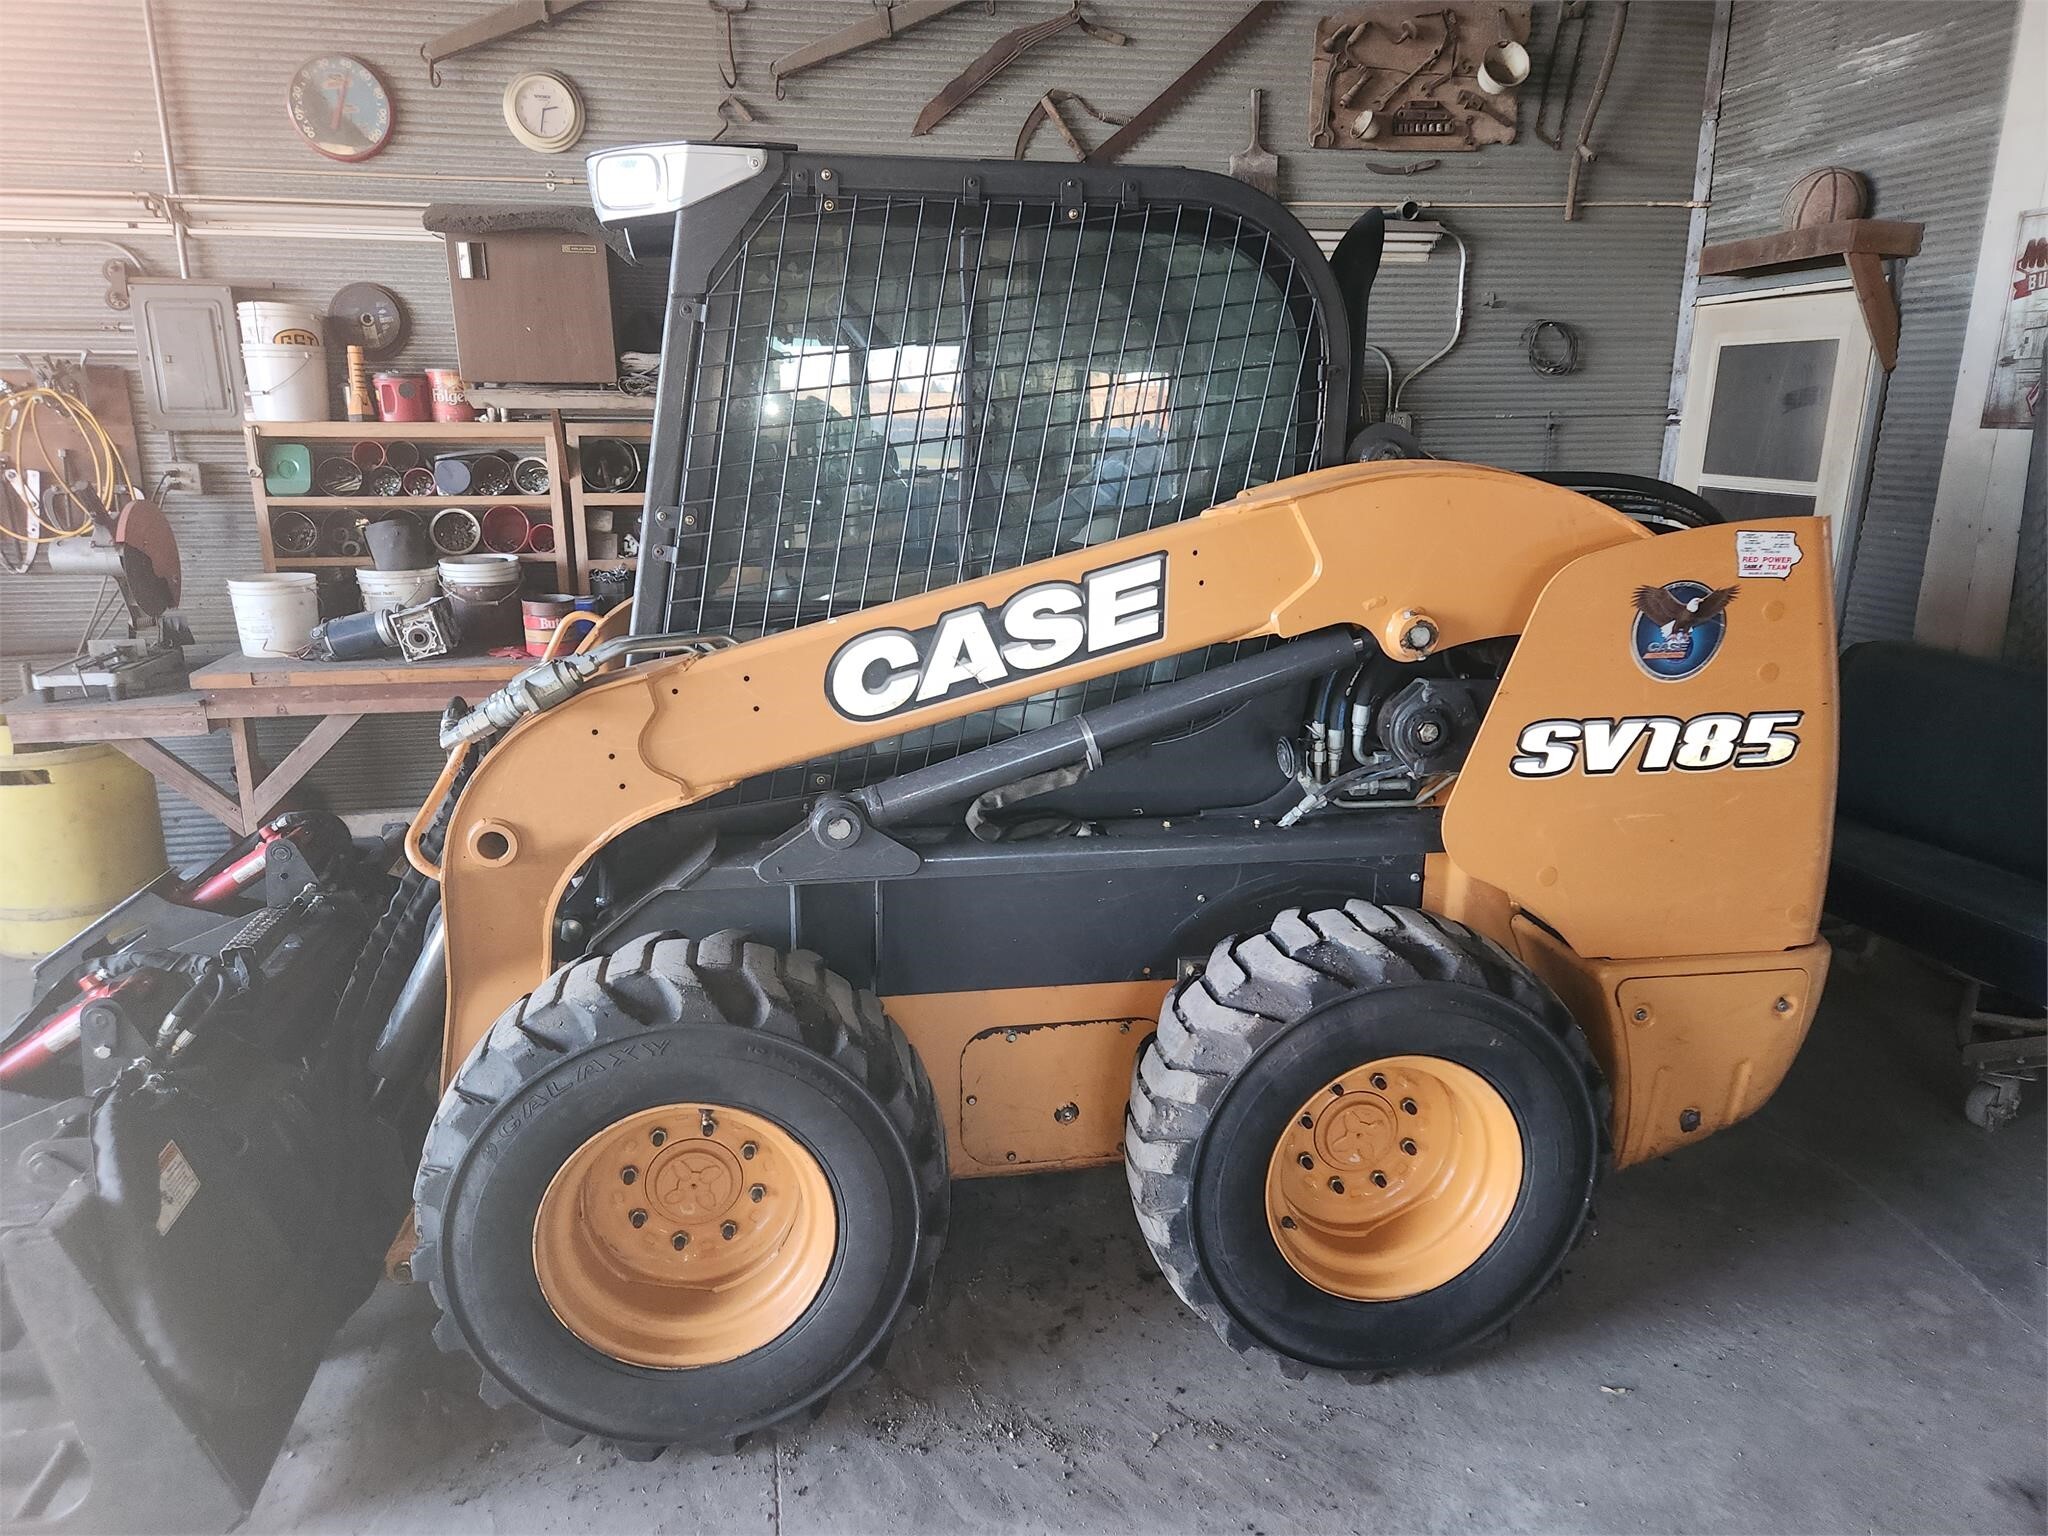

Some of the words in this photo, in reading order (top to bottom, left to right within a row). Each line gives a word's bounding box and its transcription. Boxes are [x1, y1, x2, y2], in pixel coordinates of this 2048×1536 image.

[431, 387, 467, 406] Folge
[539, 617, 562, 630] But
[827, 552, 1167, 720] CASE
[1509, 711, 1804, 778] SV185
[497, 1037, 673, 1136] GALAXY
